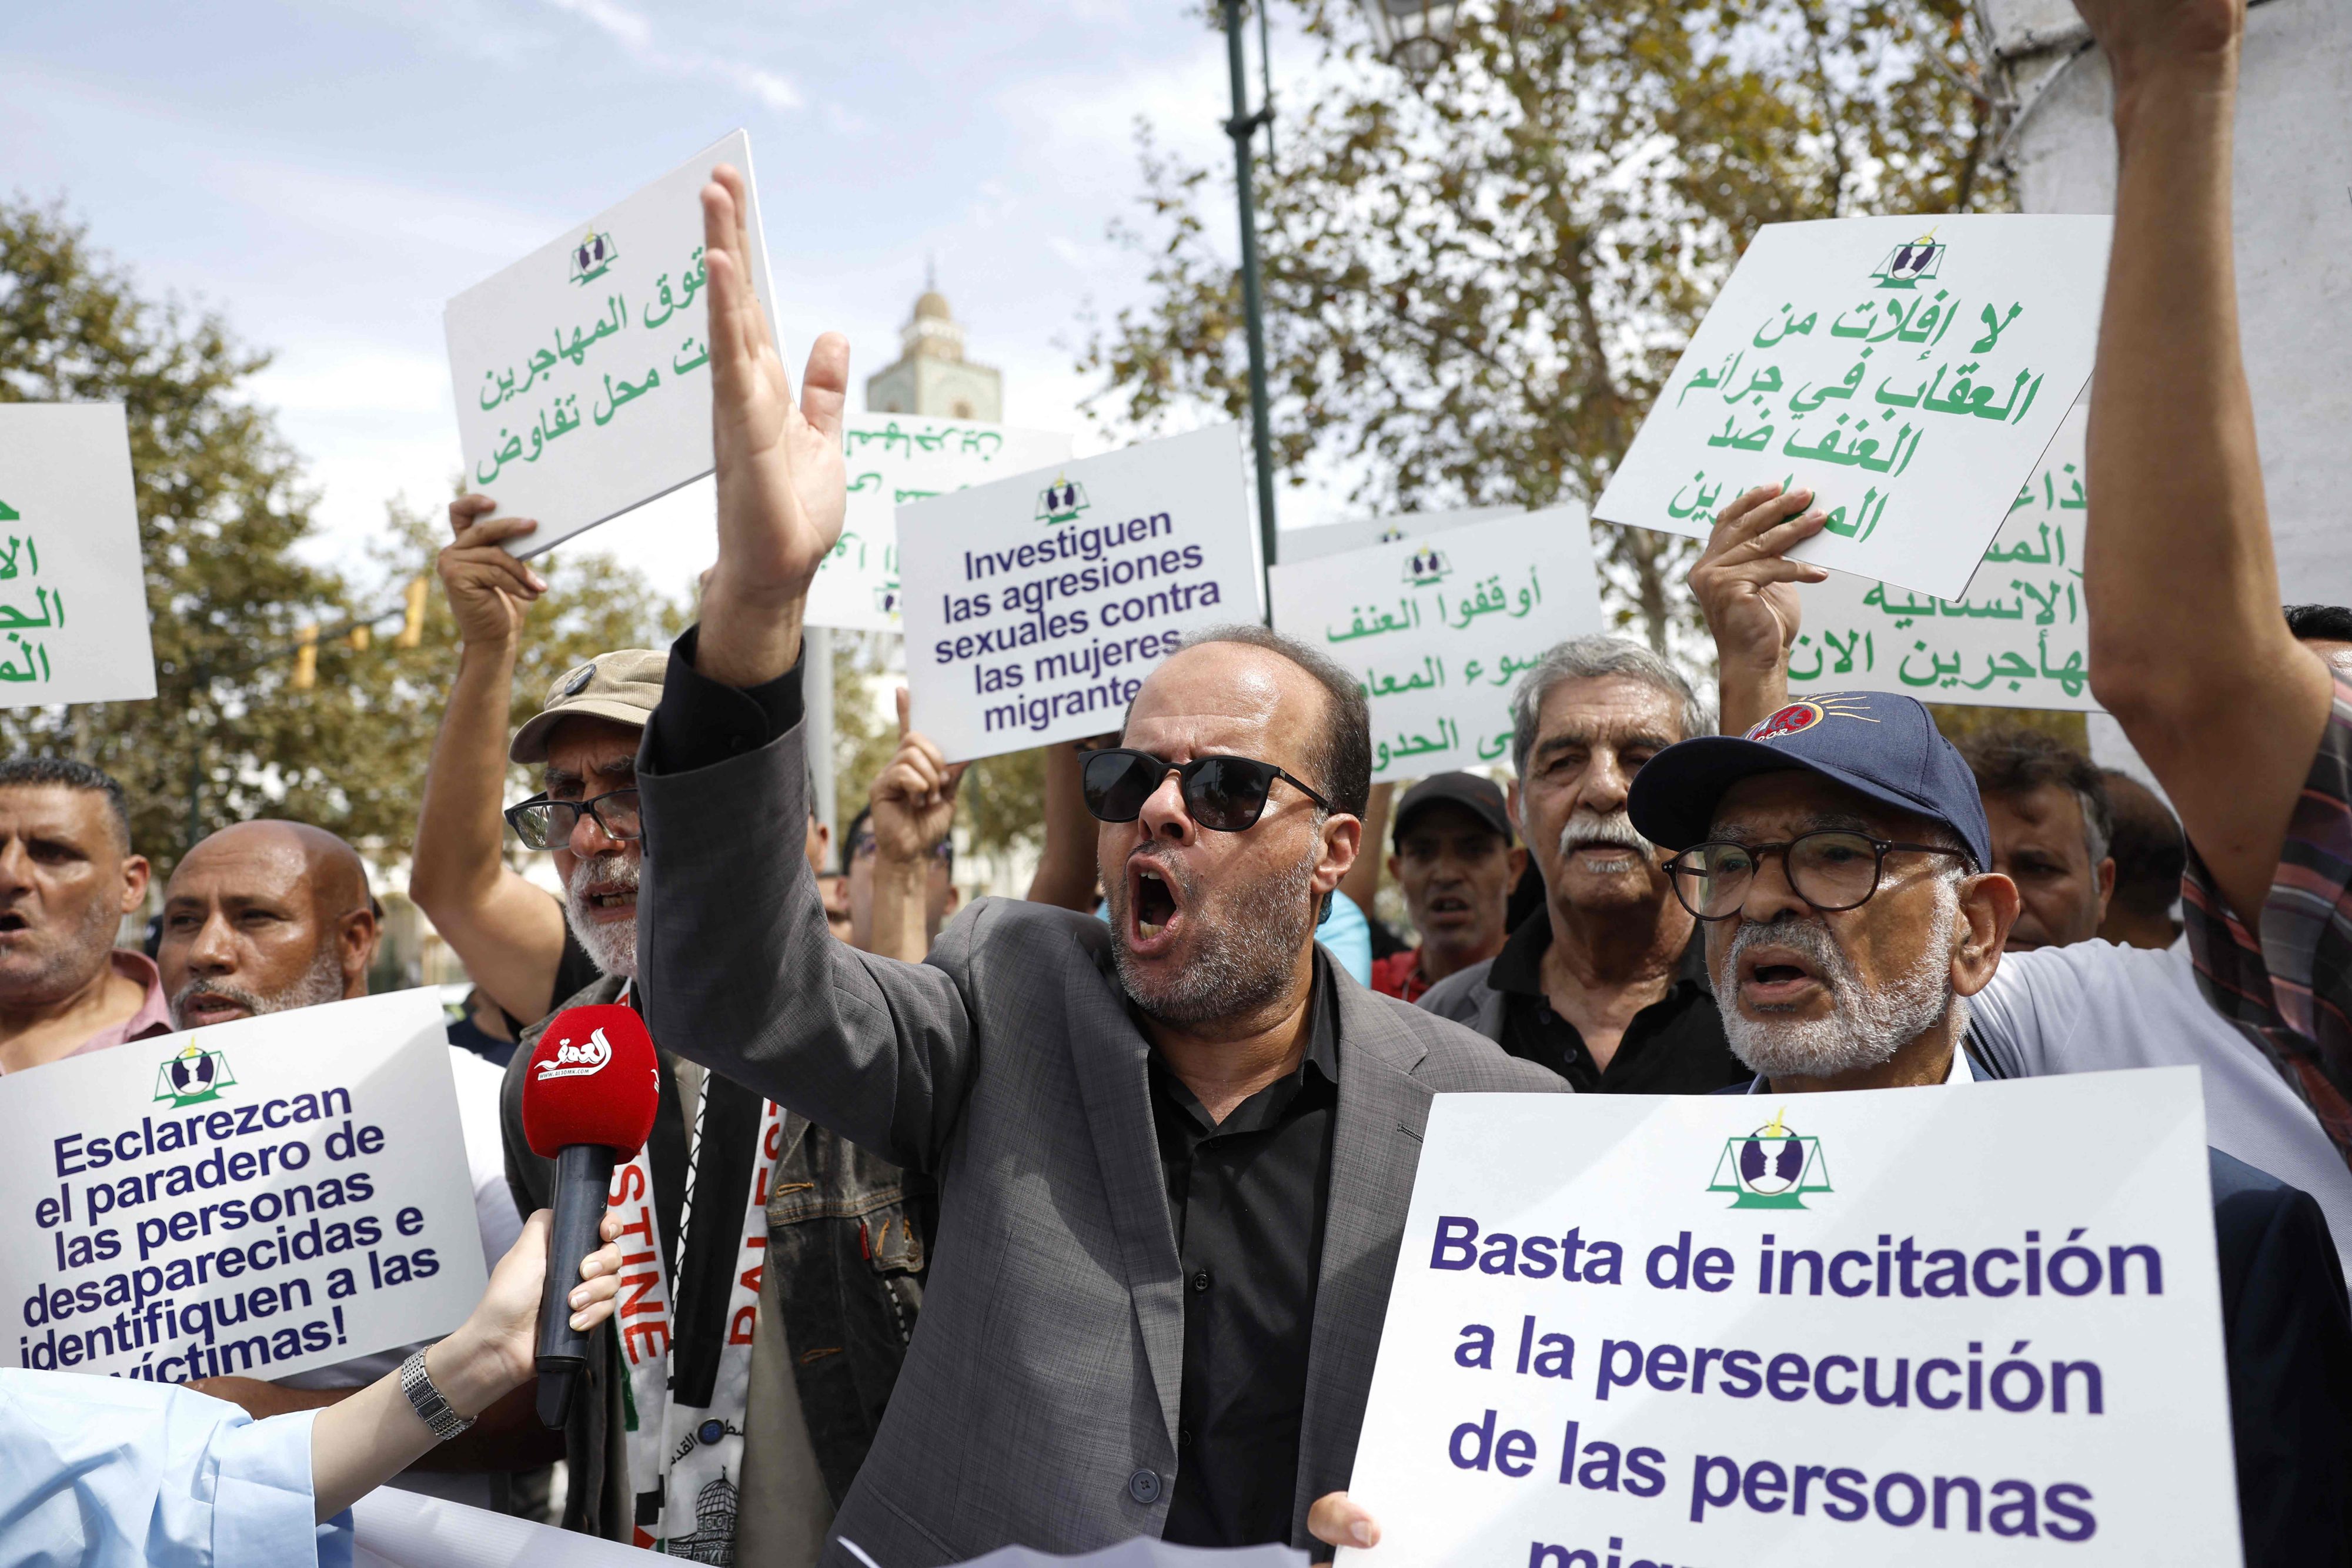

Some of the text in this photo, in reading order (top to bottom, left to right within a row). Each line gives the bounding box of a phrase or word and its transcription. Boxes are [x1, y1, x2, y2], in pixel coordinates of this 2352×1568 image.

[480, 246, 707, 411] قوق المهاجرين
[1752, 302, 1818, 348] من
[1970, 301, 2023, 354] لا
[477, 367, 660, 485] محل تفاوض
[1678, 347, 2043, 425] العقاب في جرائم
[1707, 408, 1923, 477] العنف ضد
[944, 544, 1203, 624] las agresiones
[965, 512, 1172, 581] Investiguen
[936, 581, 1221, 664] sexuales contra
[1327, 564, 1542, 643] أوقفوا العنف
[975, 630, 1181, 694] las mujeres
[985, 677, 1142, 731] migrante
[1372, 717, 1459, 773] الحدو
[54, 1087, 353, 1178] Esclarezcan
[35, 1120, 385, 1229] el paradero de
[55, 1172, 374, 1272] las personas
[1429, 1215, 2163, 1298] Basta de incitación
[23, 1206, 423, 1328] desaparecidas e
[20, 1248, 440, 1371] identifiquen a las
[1454, 1314, 2104, 1415] a la persecución
[1448, 1409, 2097, 1543] de las personas
